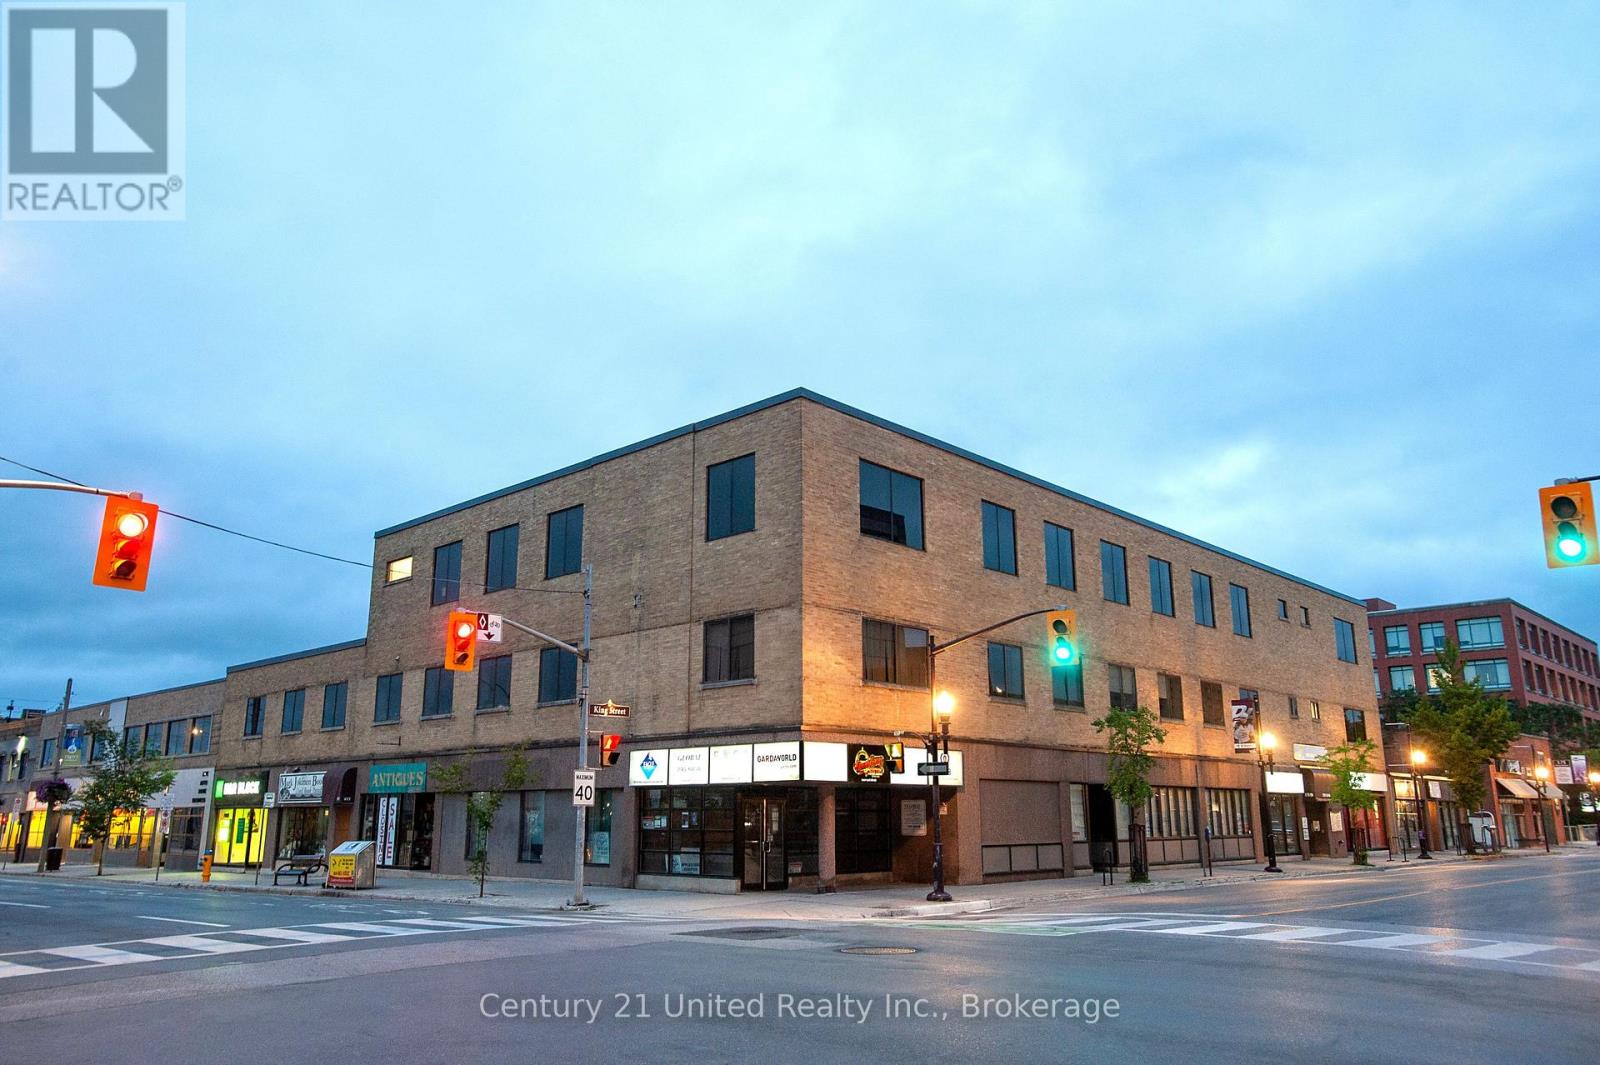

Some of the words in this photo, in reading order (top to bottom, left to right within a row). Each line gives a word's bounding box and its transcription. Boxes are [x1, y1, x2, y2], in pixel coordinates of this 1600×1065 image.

[593, 706, 608, 716] King
[609, 707, 626, 715] Street
[373, 771, 423, 787] ANTIQUES
[575, 785, 592, 801] 40
[377, 799, 386, 862] CLOSING
[386, 803, 395, 859] SALE
